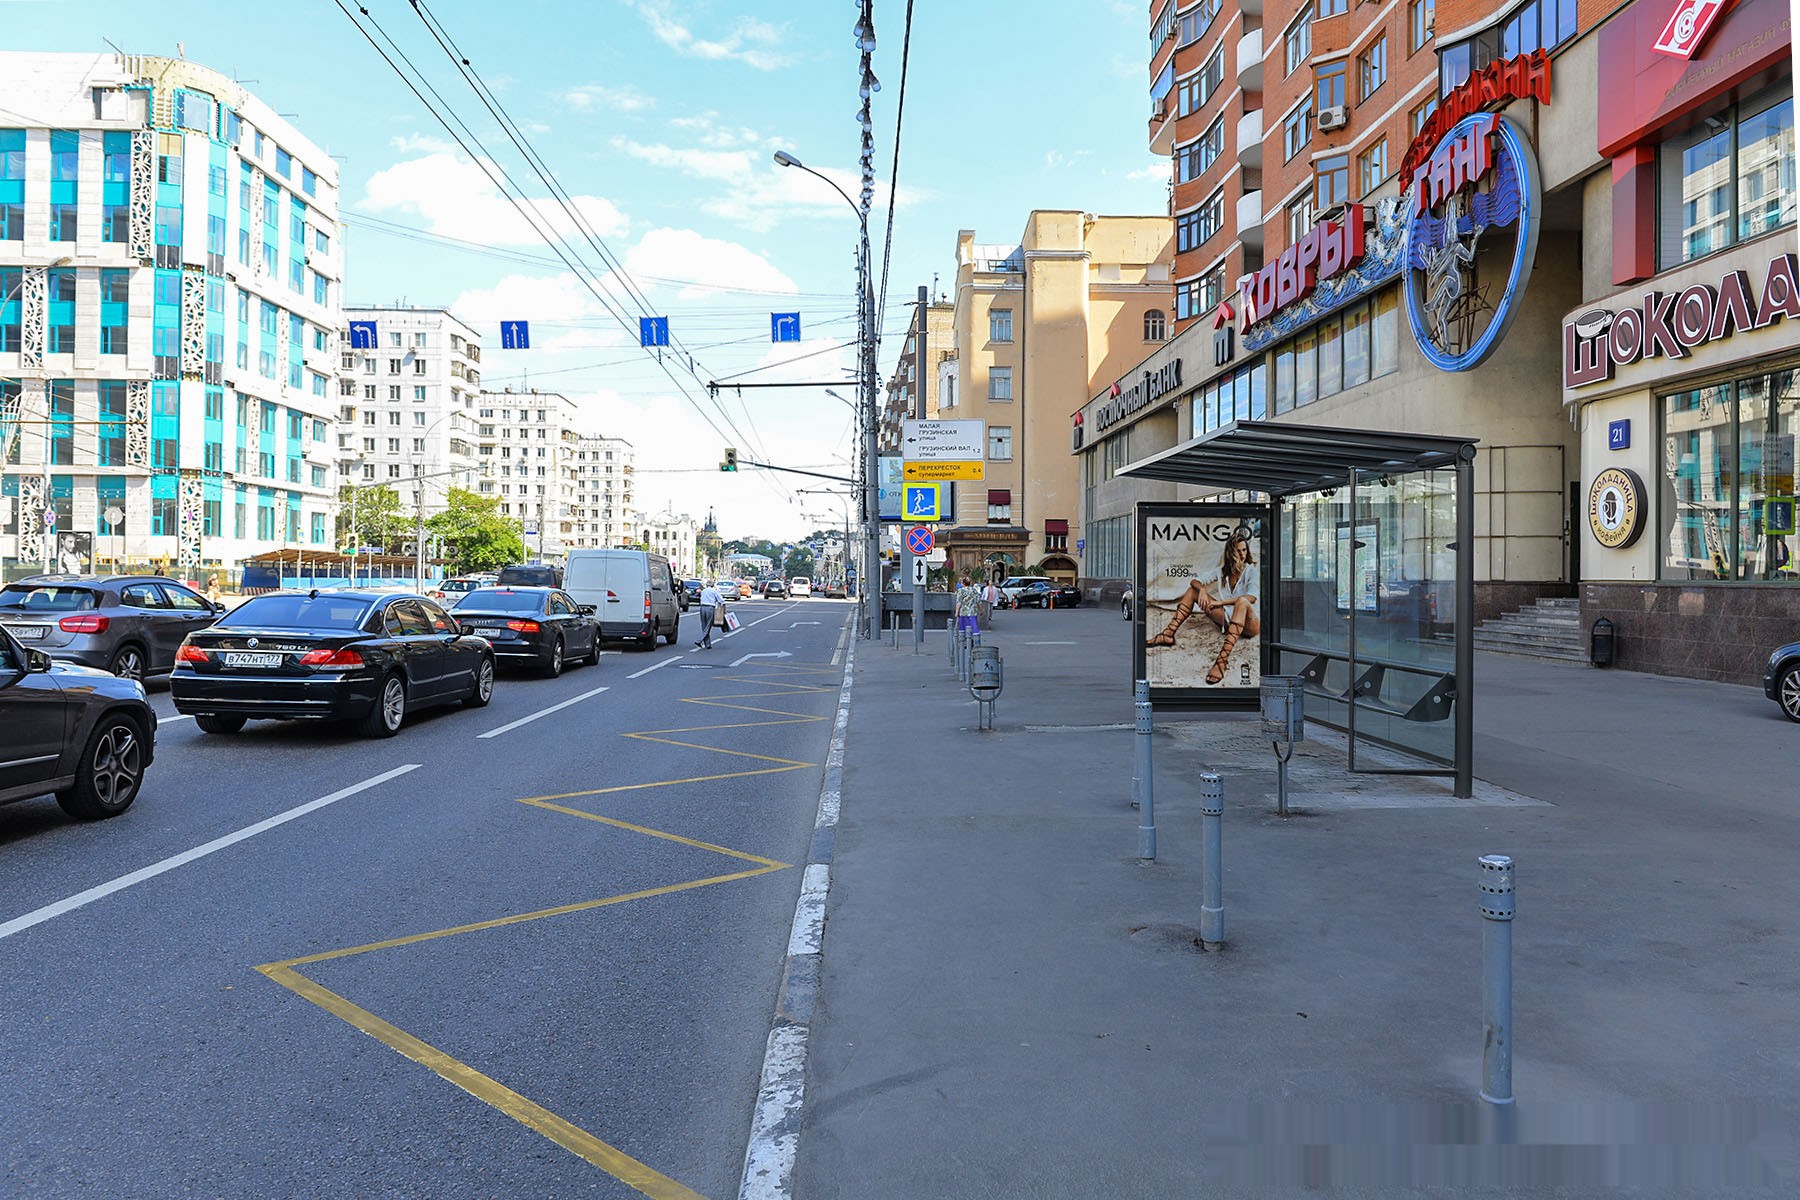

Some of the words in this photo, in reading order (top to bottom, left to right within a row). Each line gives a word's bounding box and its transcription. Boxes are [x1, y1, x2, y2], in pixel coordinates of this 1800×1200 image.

[1727, 28, 1776, 63] МАГАЗИН
[1414, 113, 1502, 219] ГАНГ
[1240, 202, 1364, 335] КОВРЫ
[1150, 358, 1183, 401] БАНК
[1612, 427, 1623, 443] 21
[1590, 473, 1634, 516] ШОКОЛАДНИЦА
[1151, 523, 1253, 542] MANGO
[1596, 527, 1627, 543] кофейня
[228, 653, 264, 663] В747НТ
[266, 653, 280, 662] 177
